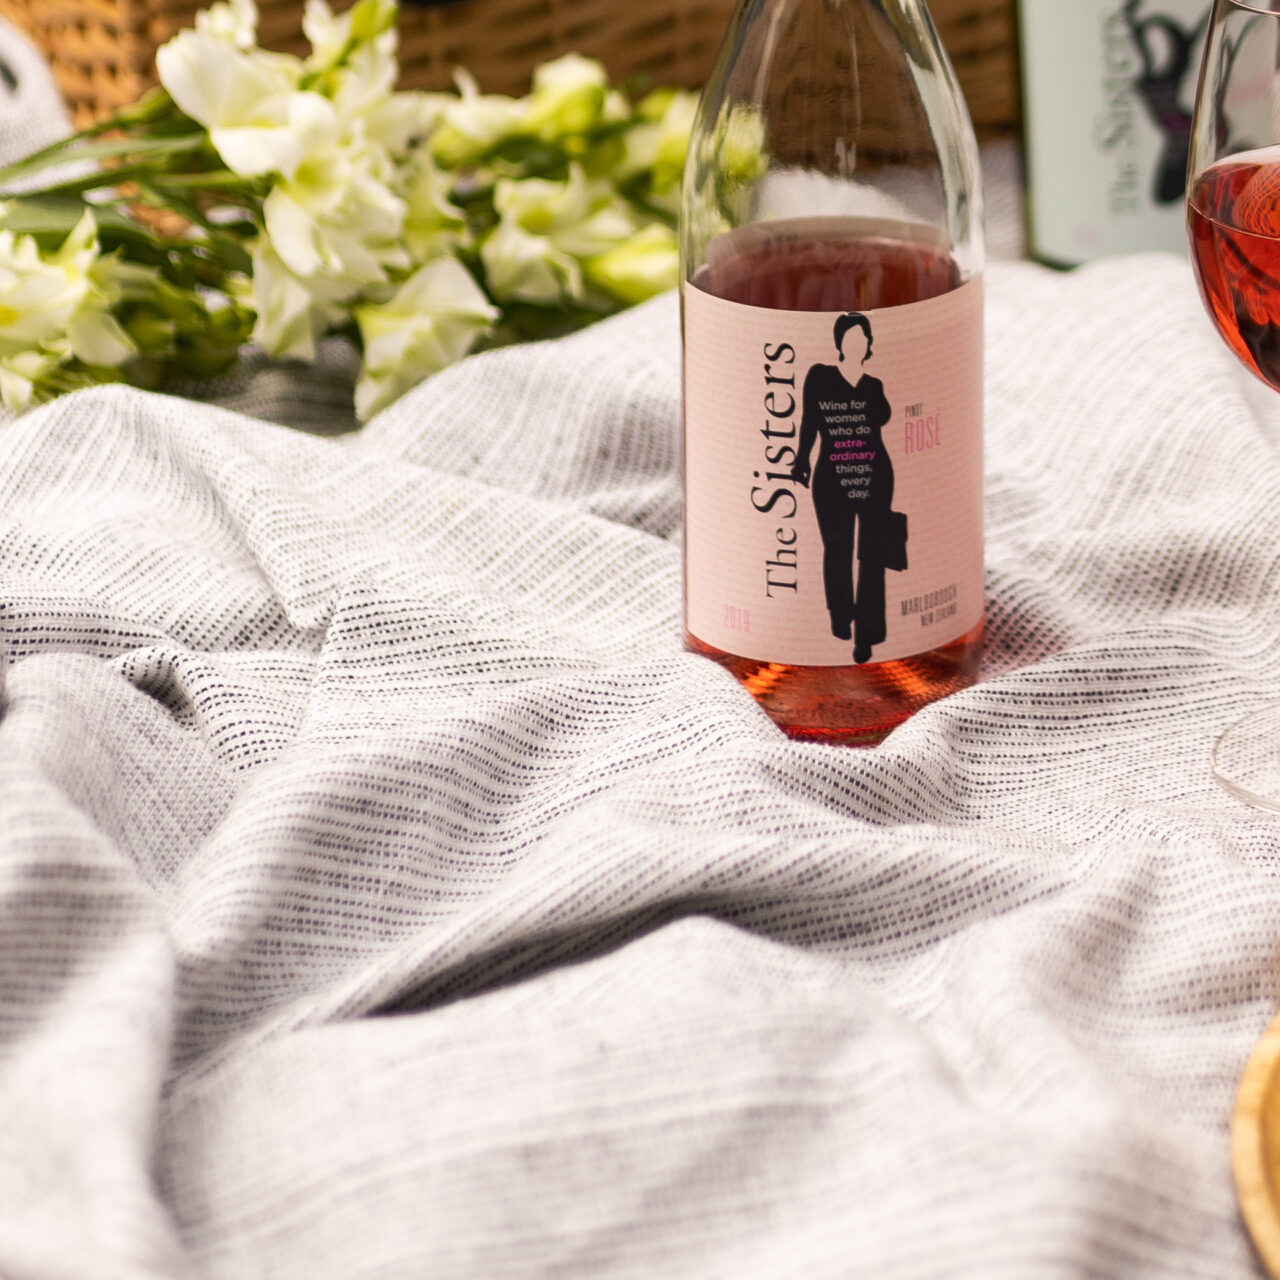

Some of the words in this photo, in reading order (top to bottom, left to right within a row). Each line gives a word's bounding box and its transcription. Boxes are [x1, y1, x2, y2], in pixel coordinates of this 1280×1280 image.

[818, 401, 848, 410] Wine
[850, 400, 867, 409] for
[825, 414, 866, 423] women
[750, 342, 798, 519] Sisters
[828, 427, 853, 436] who
[855, 426, 871, 435] do
[904, 406, 942, 454] ROSÉ
[833, 440, 867, 449] extra-
[829, 451, 876, 461] ordinary
[840, 477, 871, 487] every
[847, 488, 870, 499] day.
[765, 527, 798, 598] The
[901, 583, 957, 616] MARLBOROUGH
[921, 612, 934, 626] NEW
